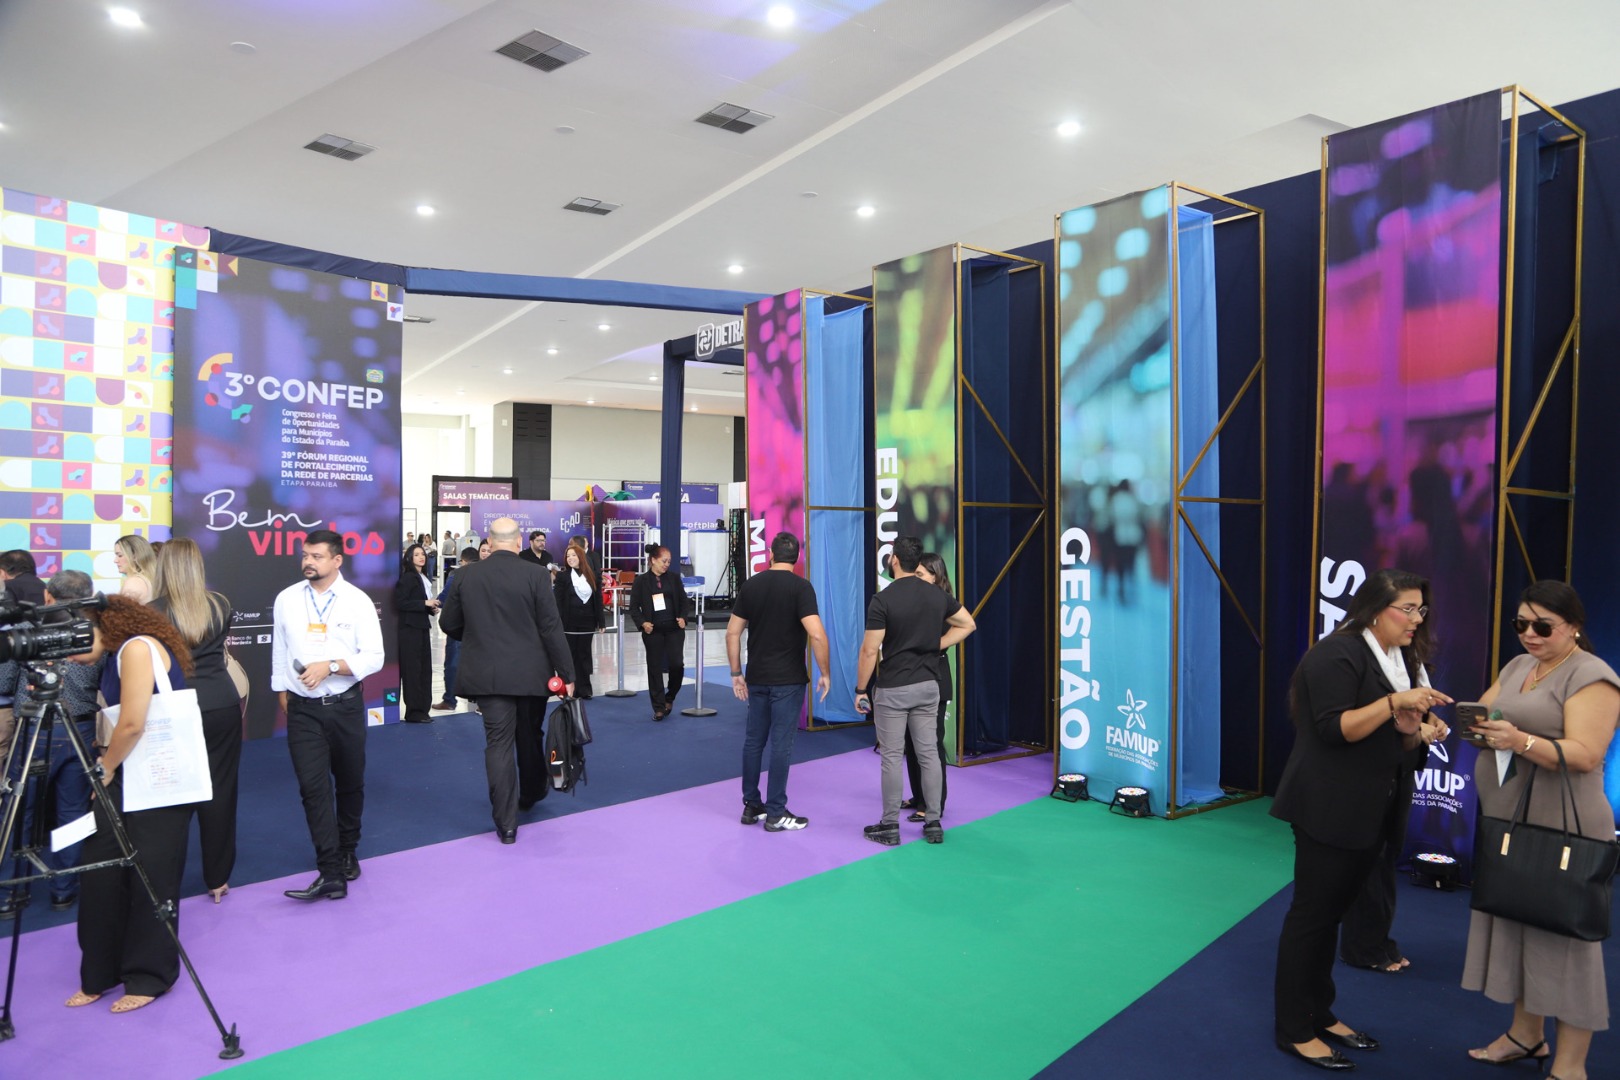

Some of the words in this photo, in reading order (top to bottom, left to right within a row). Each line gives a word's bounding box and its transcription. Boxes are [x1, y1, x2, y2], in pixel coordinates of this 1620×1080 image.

[258, 376, 384, 409] CONFEP
[282, 409, 314, 418] Congresso
[292, 419, 340, 429] Oportunidades
[299, 428, 332, 438] Municípios
[292, 436, 314, 444] Estado
[326, 439, 350, 447] Paraíba
[297, 451, 327, 460] FÓRUM
[329, 454, 369, 463] REGIONAL
[294, 462, 367, 472] FORTALECIMENTO
[330, 473, 373, 481] PARCERIAS
[202, 489, 322, 531] Bem
[560, 512, 580, 533] ECAD
[248, 520, 385, 556] vinos
[1060, 528, 1100, 750] GESTÃO
[1106, 725, 1159, 757] FAMUP
[1427, 794, 1463, 808] ASSOCIAÇÕES
